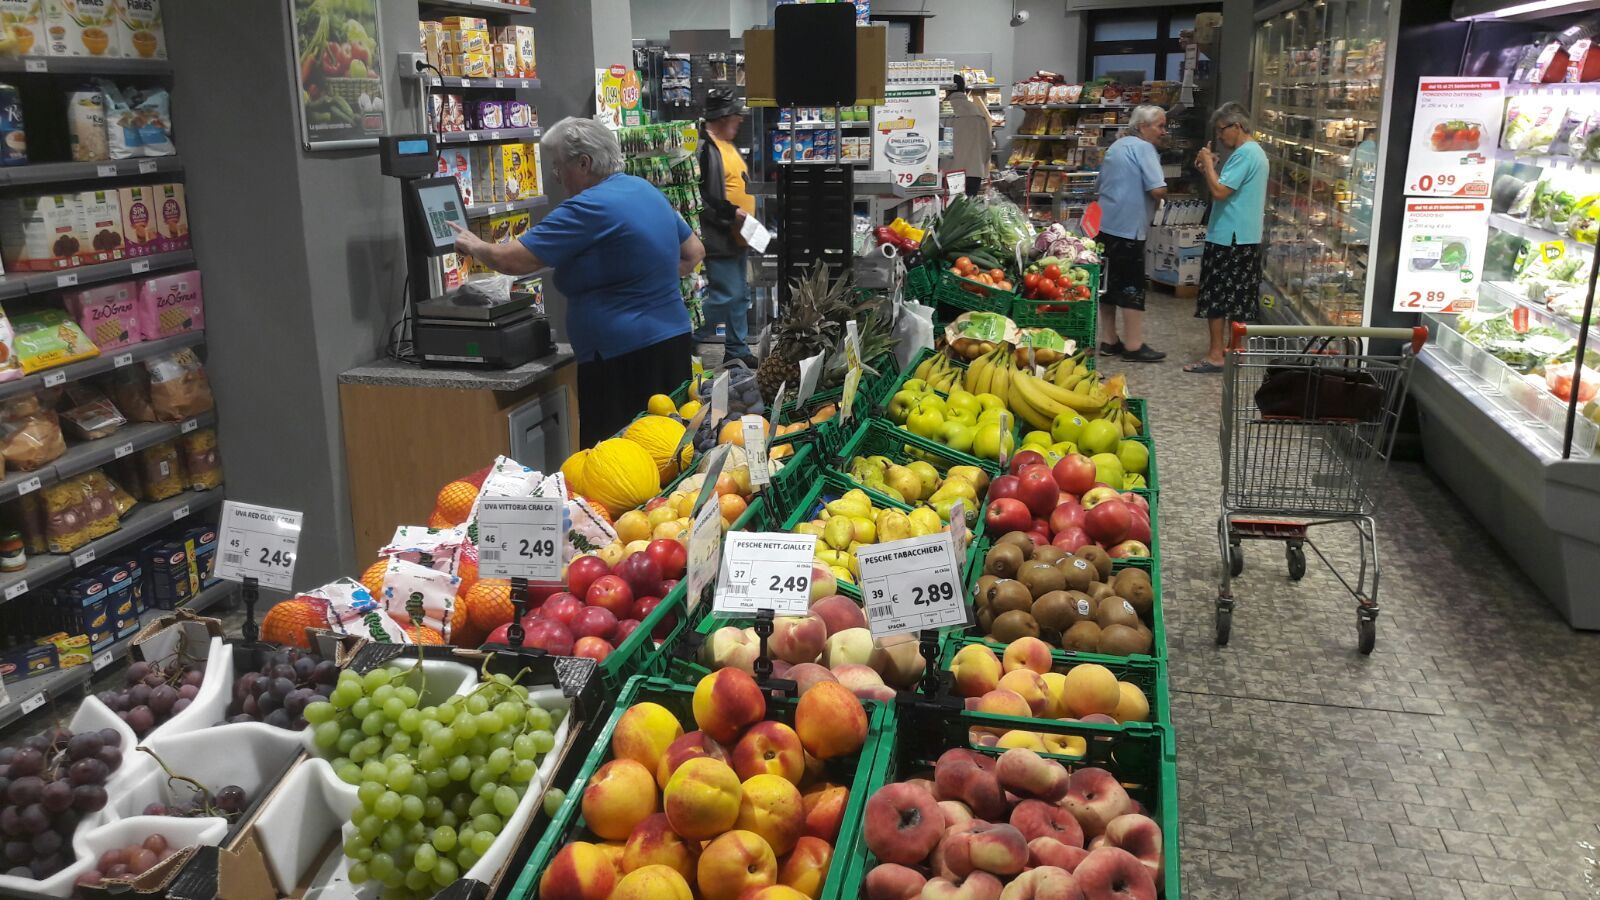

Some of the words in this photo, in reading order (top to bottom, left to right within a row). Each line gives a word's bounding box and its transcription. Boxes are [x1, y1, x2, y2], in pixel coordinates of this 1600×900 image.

[230, 539, 240, 548] 45
[485, 535, 495, 543] 46
[244, 548, 250, 556] €
[260, 548, 292, 568] 2,49
[501, 542, 508, 551] €
[520, 539, 554, 559] 2,49
[865, 554, 892, 564] PESCHE
[893, 545, 944, 559] TABACCHIERA
[769, 575, 808, 593] 2,49
[872, 589, 884, 599] 39
[892, 594, 899, 603] €
[912, 582, 953, 606] 2,89
